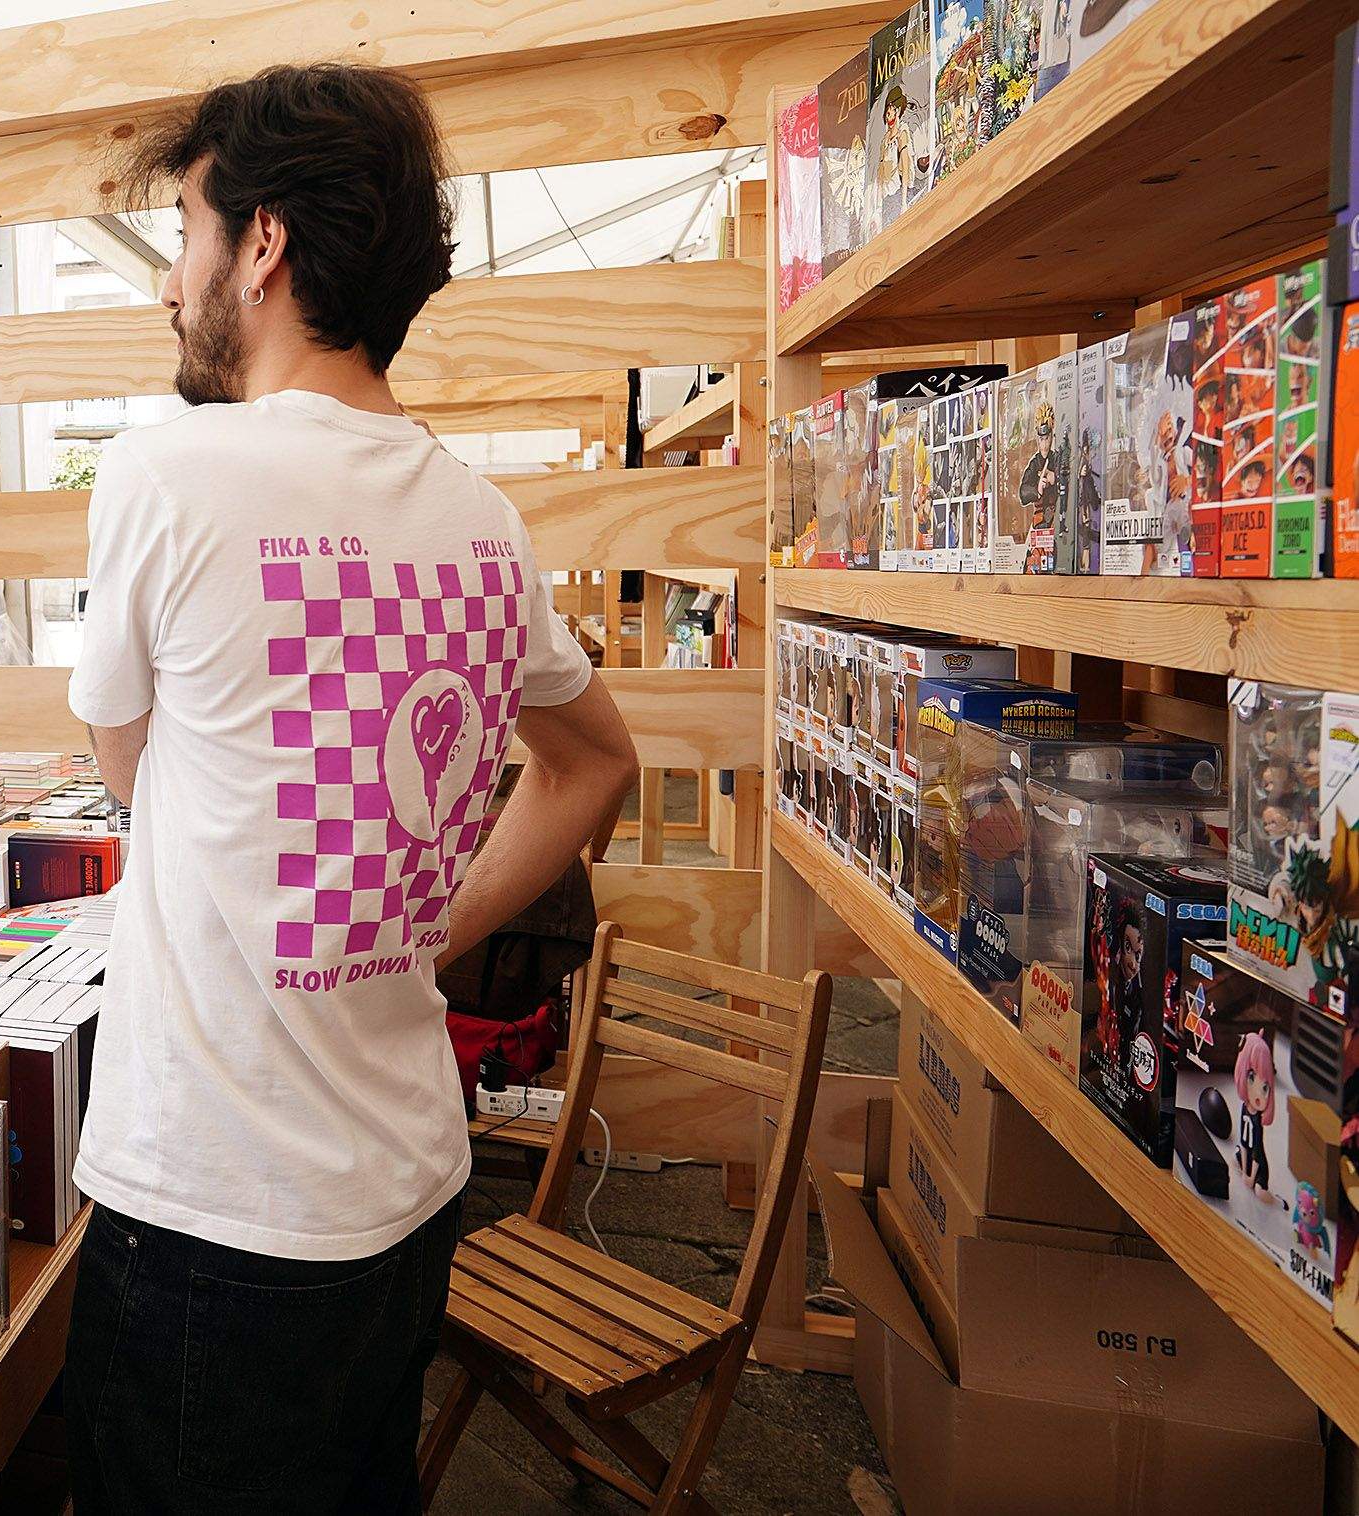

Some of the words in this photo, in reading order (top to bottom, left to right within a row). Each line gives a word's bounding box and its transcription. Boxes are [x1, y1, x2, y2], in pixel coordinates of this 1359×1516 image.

[906, 372, 984, 398] ペイン
[259, 537, 311, 557] FIKA
[318, 536, 334, 556] &
[340, 536, 369, 556] CO.
[471, 540, 499, 558] FIKA
[1233, 533, 1249, 551] ACE
[85, 857, 93, 889] GOODBYE
[1145, 892, 1166, 917] SEGA
[1177, 903, 1227, 922] SEGA
[275, 965, 343, 993] SLOW
[345, 952, 413, 984] DOWN
[1190, 953, 1214, 981] SEGA
[1097, 1329, 1138, 1352] 580
[1147, 1335, 1177, 1357] BJ
